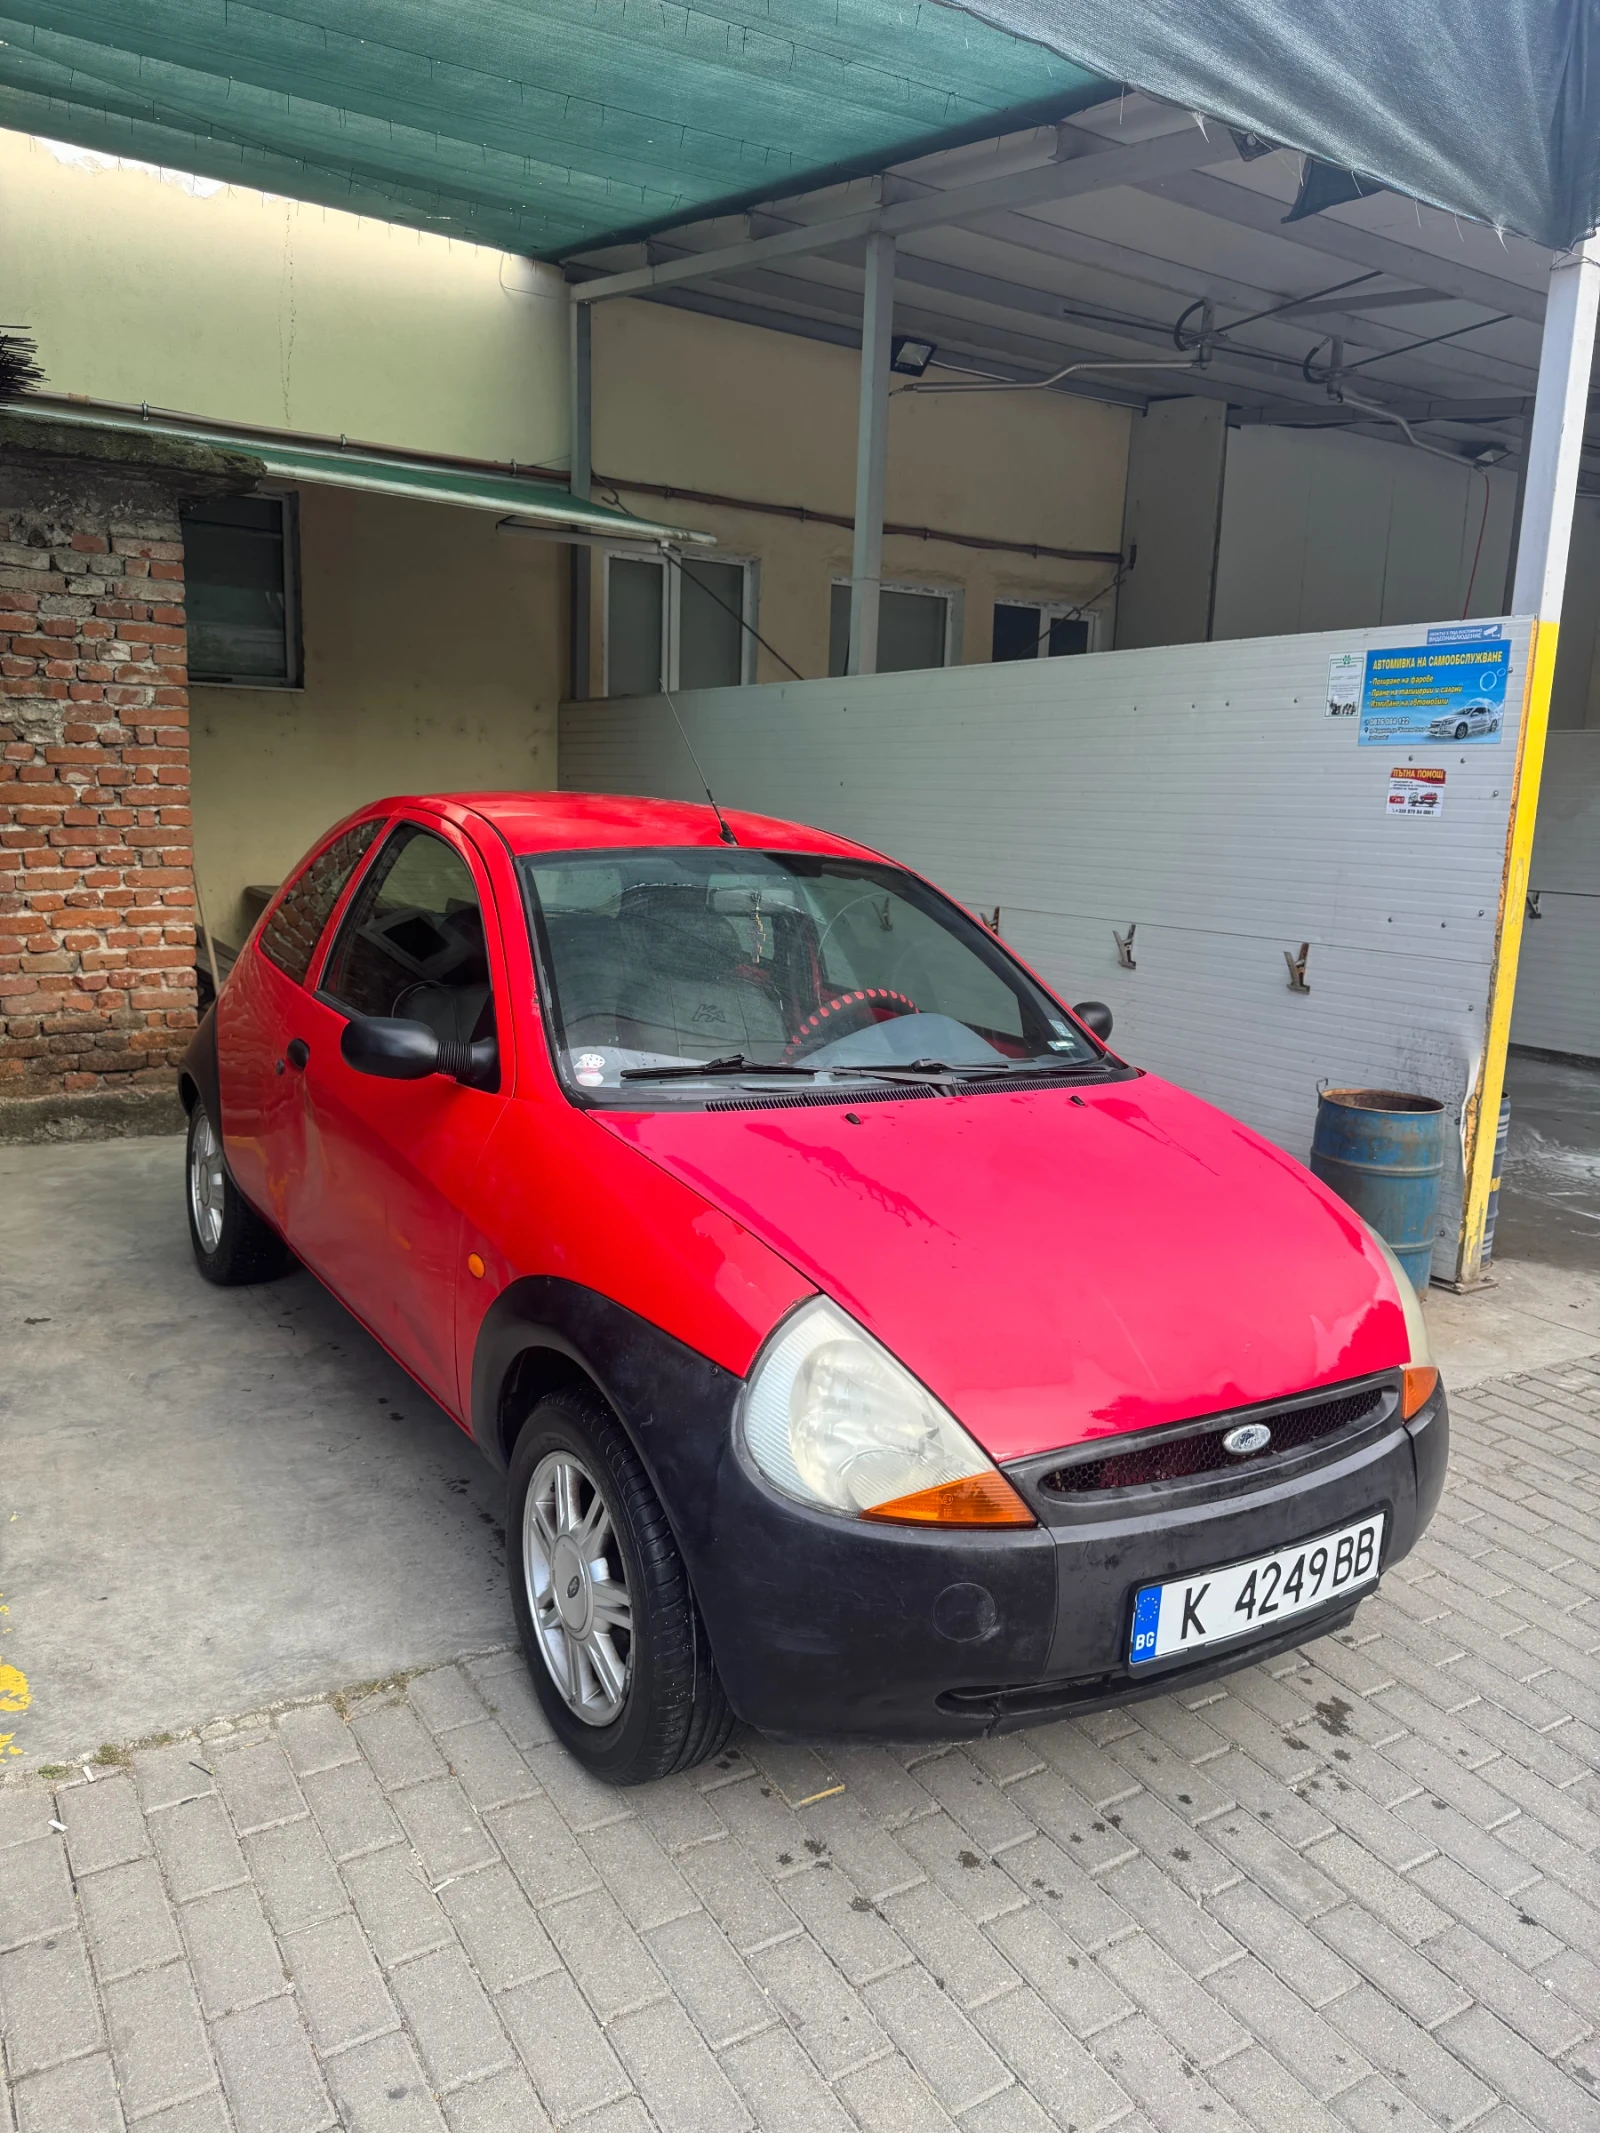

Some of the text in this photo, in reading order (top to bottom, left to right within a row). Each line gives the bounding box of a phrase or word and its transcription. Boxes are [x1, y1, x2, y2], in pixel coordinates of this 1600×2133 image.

[1428, 632, 1482, 643] ВИДЕОНАБЛЮДЕНИЕ
[1372, 651, 1503, 670] АВТОМИВКА НА САМООБСЛУЖВАНЕ
[1393, 769, 1444, 780] ПЪТНА ПОМОЩ
[1180, 1582, 1211, 1640] K
[1135, 1631, 1155, 1651] BG
